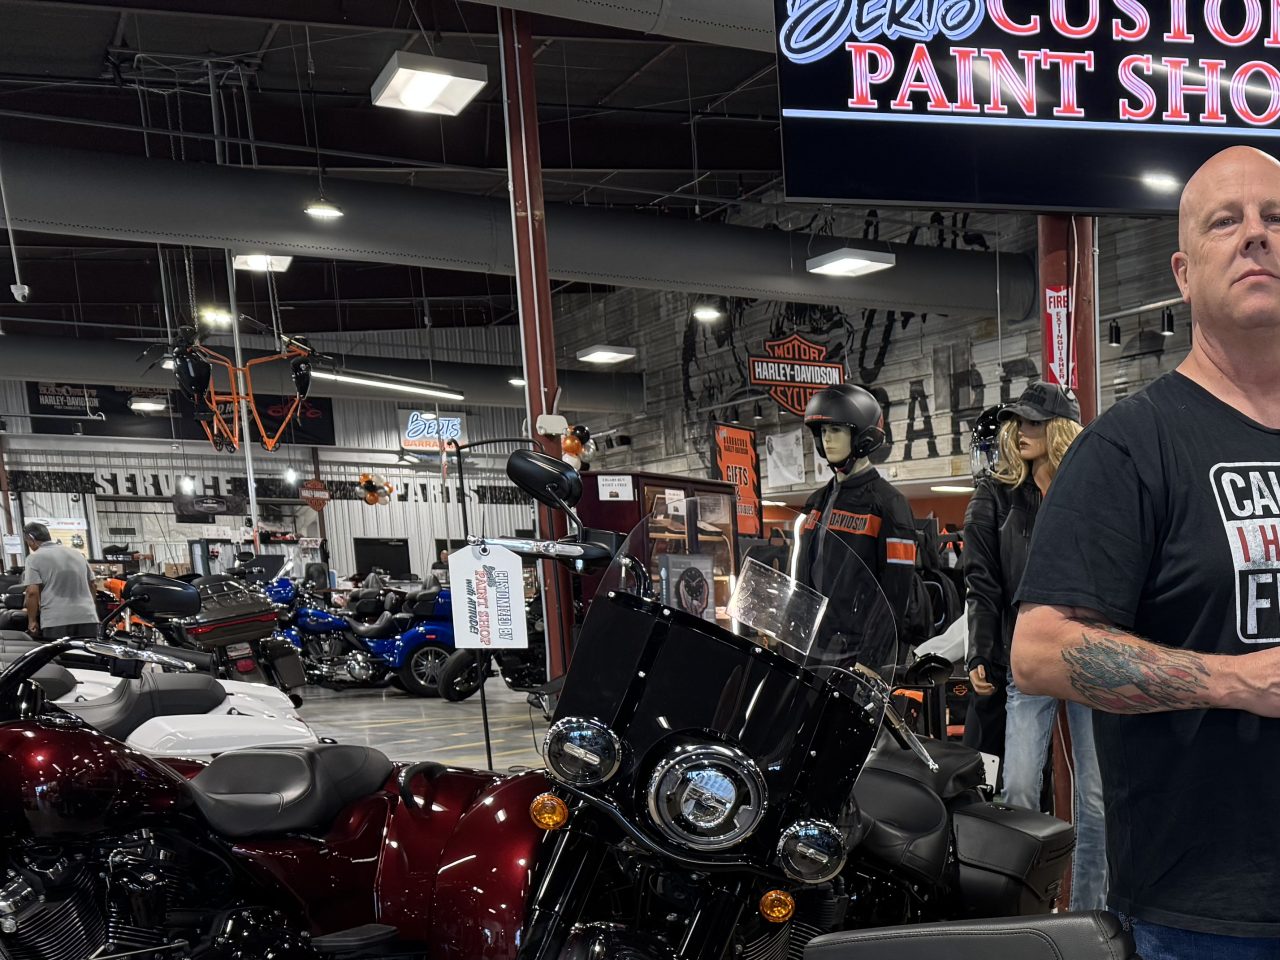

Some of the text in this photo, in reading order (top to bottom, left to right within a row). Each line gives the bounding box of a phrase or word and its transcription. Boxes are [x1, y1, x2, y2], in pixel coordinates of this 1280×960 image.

[845, 41, 1094, 116] PAINT
[1048, 295, 1069, 310] FIRE
[774, 340, 822, 361] MOTOR
[1055, 311, 1066, 380] EXTINGUISHER
[754, 362, 841, 386] HARLEY-DAVIDSON
[776, 386, 819, 411] CYCLE
[93, 472, 233, 497] SERVCE
[726, 463, 749, 486] GIFTS
[1236, 525, 1251, 563] I
[465, 579, 478, 634] with ATTITUDE!
[475, 570, 491, 645] PAINT SHOP
[495, 570, 513, 640] CUSTOMIZED BY
